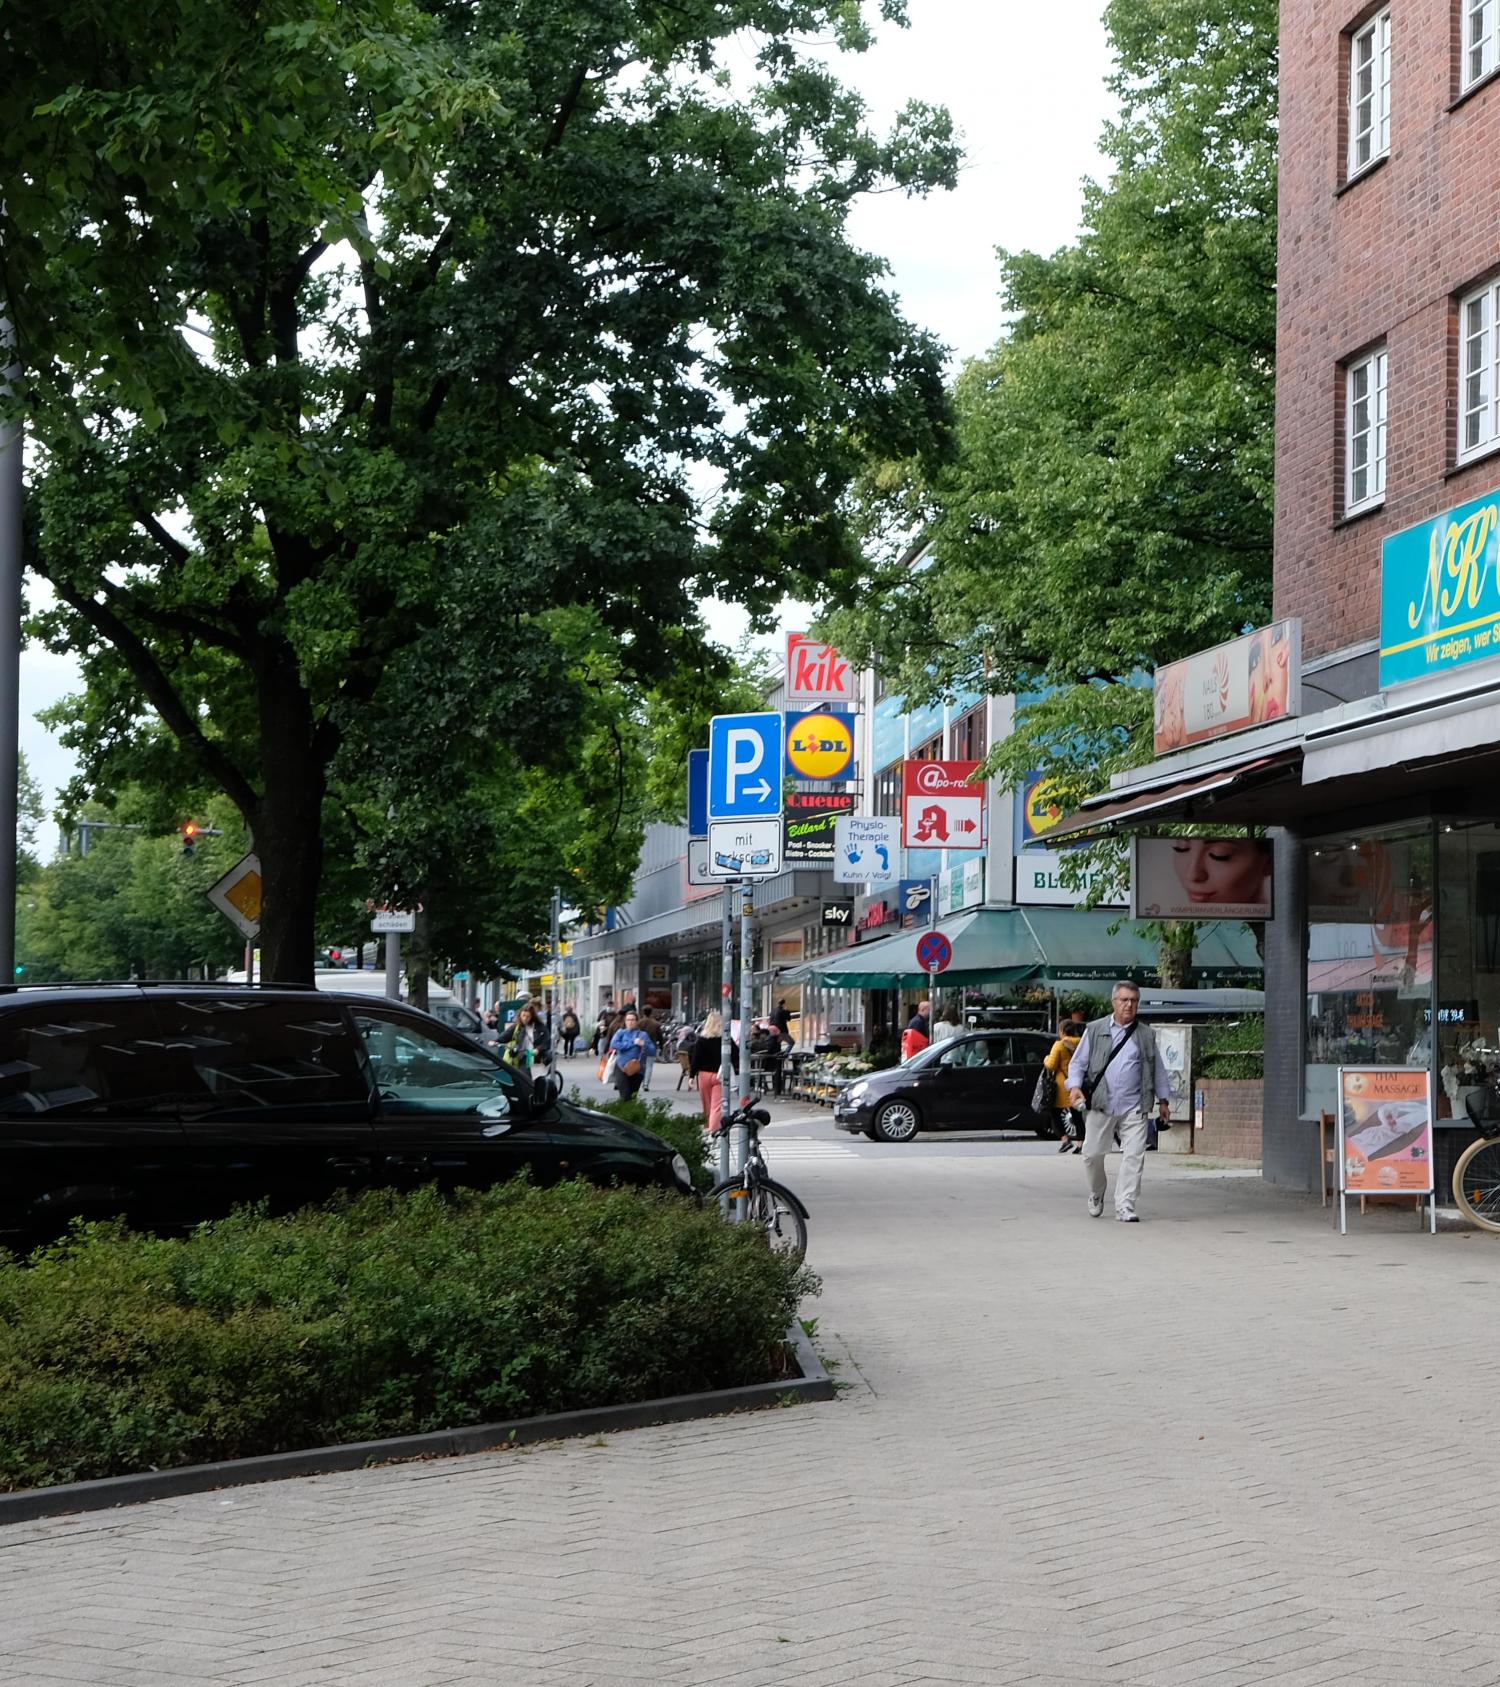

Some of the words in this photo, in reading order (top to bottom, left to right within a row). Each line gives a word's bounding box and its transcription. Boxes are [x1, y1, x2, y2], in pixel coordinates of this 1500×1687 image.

[1426, 643, 1440, 665] Wir
[1440, 636, 1472, 661] zeigen,
[1474, 629, 1492, 649] wer
[785, 791, 852, 809] Queue
[787, 819, 827, 838] Billard
[735, 832, 753, 846] mit
[847, 832, 890, 842] Therapie
[787, 841, 803, 849] Pool
[842, 871, 864, 879] Kuhn
[825, 906, 850, 922] sky
